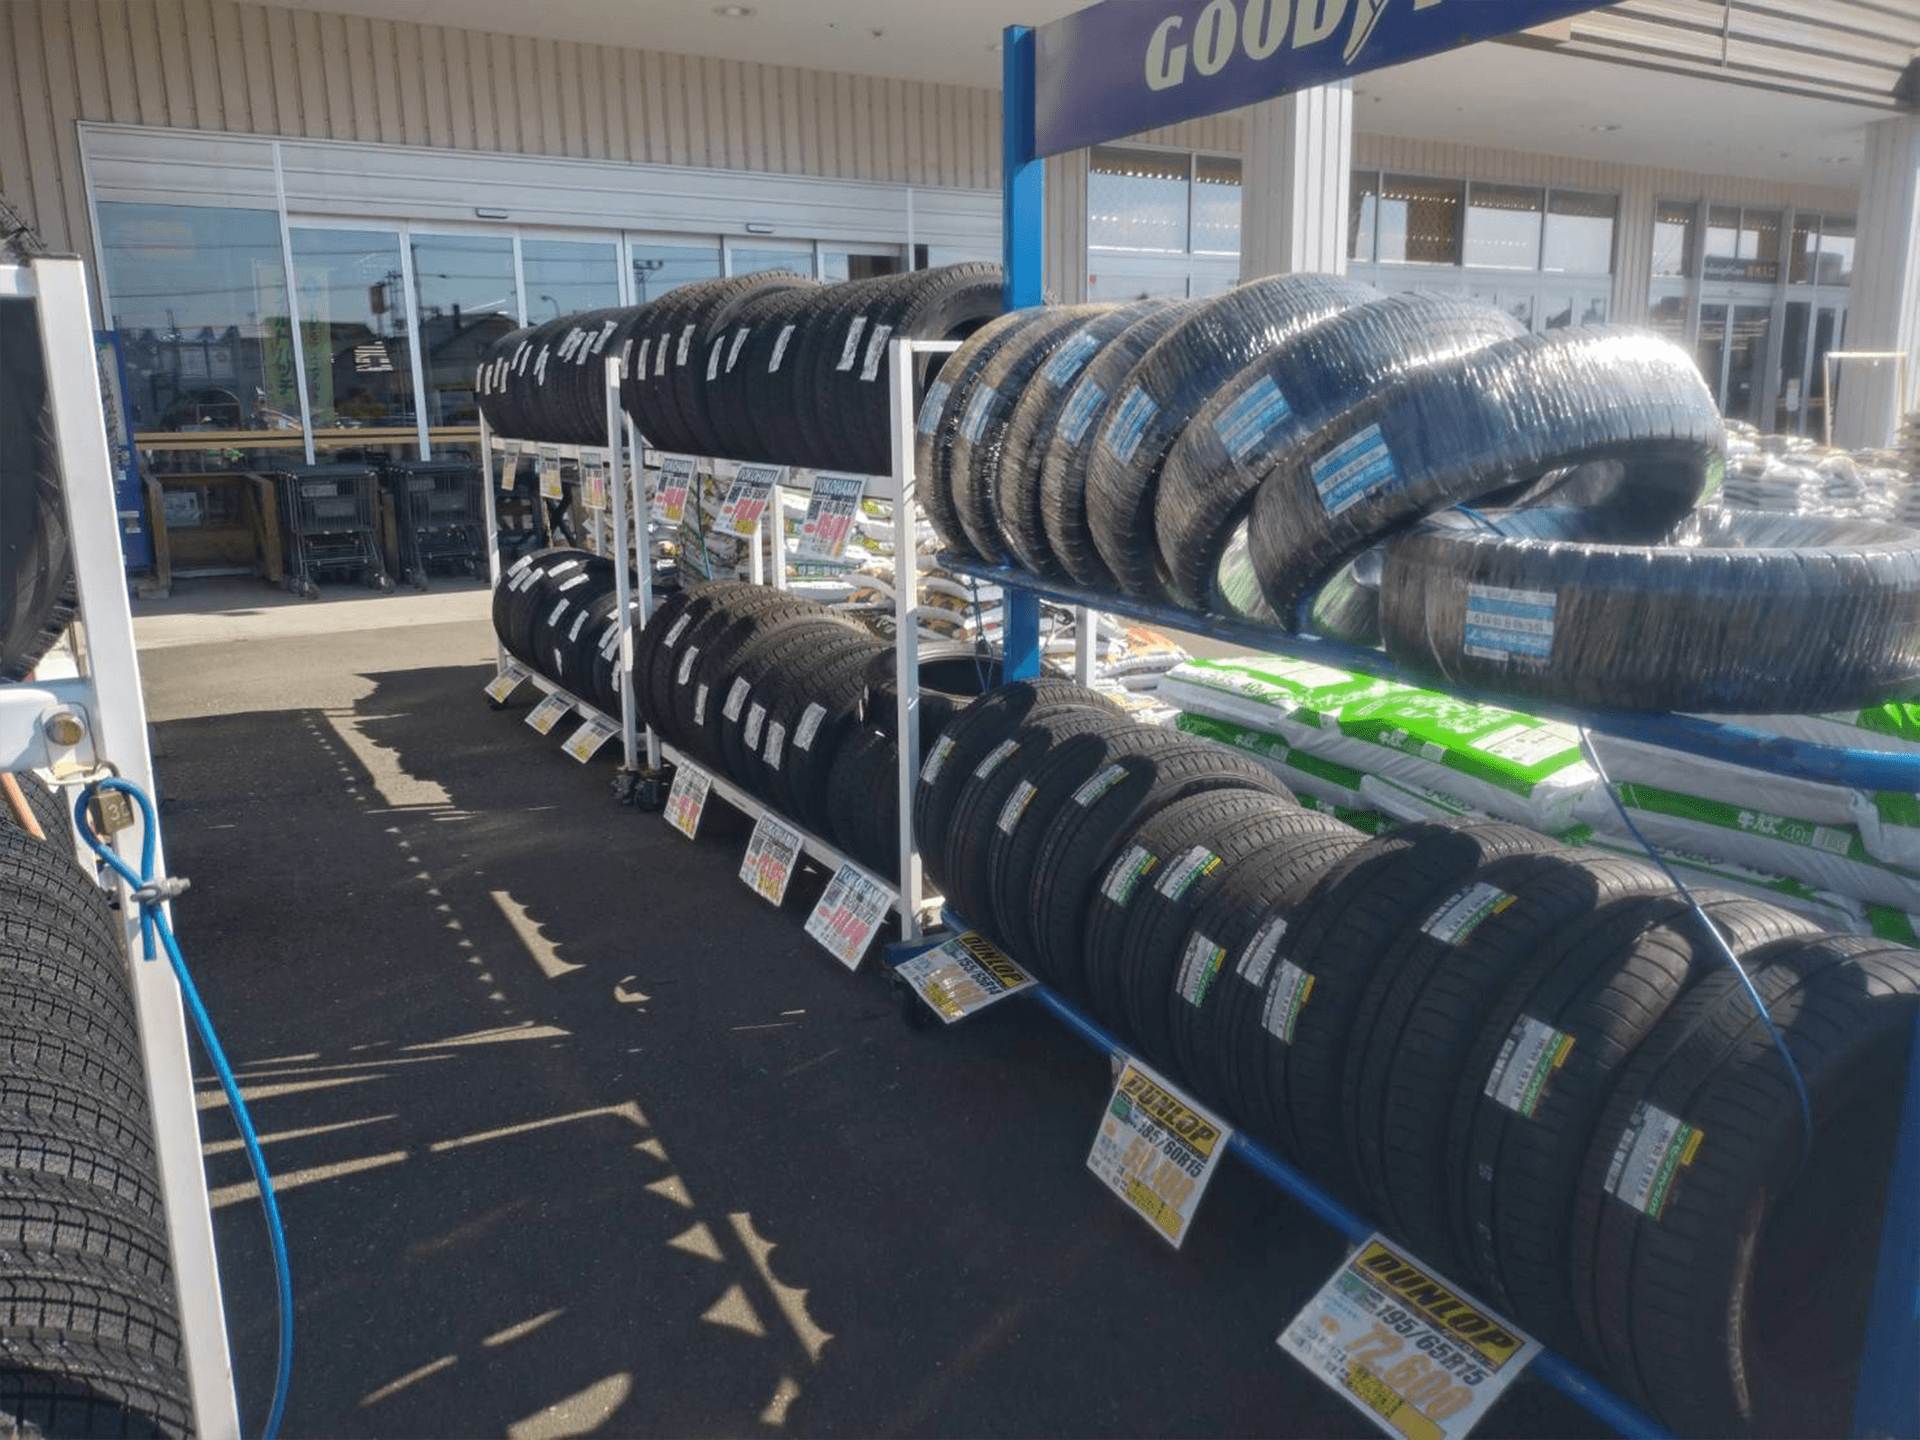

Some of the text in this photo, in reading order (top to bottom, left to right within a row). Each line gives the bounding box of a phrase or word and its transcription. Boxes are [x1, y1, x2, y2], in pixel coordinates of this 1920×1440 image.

[961, 935, 1025, 983] DUNLOP
[1123, 1074, 1217, 1143] DUNLOP
[1362, 1250, 1517, 1350] DUNLOP
[1375, 1298, 1488, 1386] 195/65R15
